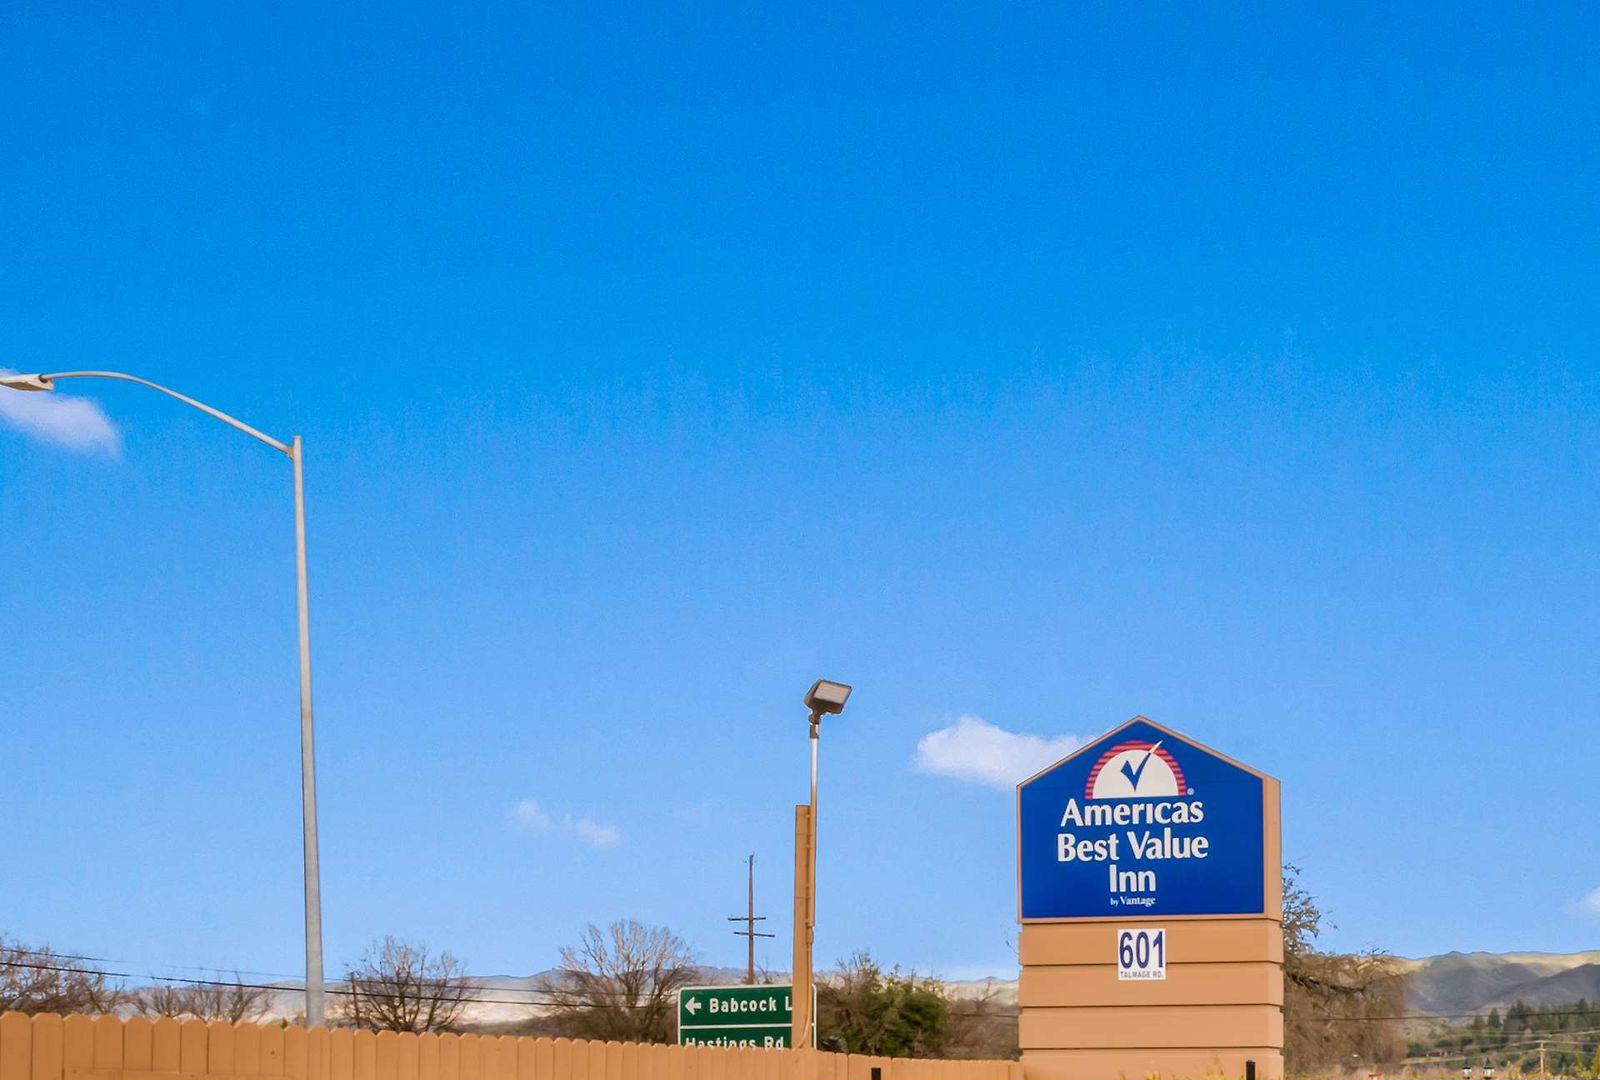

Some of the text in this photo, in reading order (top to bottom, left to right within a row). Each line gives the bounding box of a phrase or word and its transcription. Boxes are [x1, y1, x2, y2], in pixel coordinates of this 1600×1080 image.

[1059, 798, 1205, 827] Americas
[1057, 827, 1210, 862] Best Value
[1109, 864, 1157, 893] Inn
[1110, 896, 1156, 907] by Vantage
[1119, 931, 1164, 969] 601
[709, 996, 793, 1014] Babcock L
[764, 1035, 784, 1051] Rd
